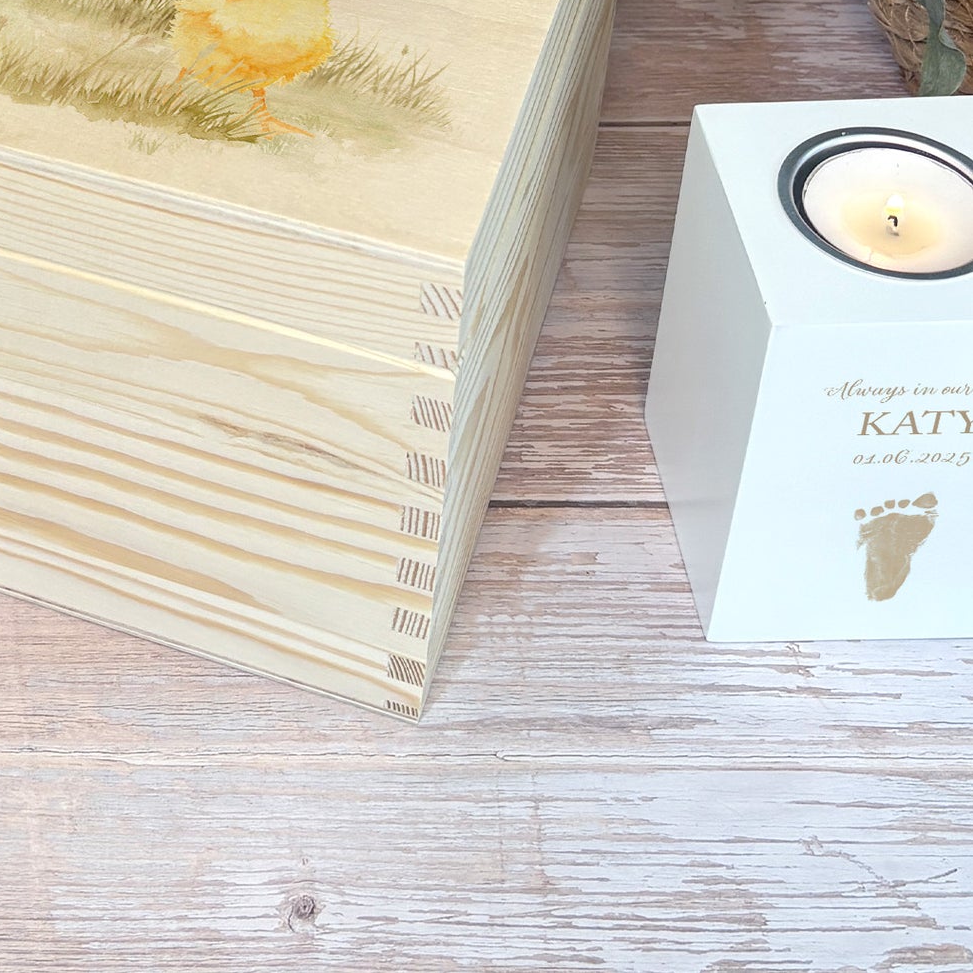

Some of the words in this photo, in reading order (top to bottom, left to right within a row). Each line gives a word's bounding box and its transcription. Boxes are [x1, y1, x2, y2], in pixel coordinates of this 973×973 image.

[824, 378, 907, 404] Always
[913, 382, 938, 396] in
[941, 383, 973, 396] our
[856, 410, 973, 436] KATY
